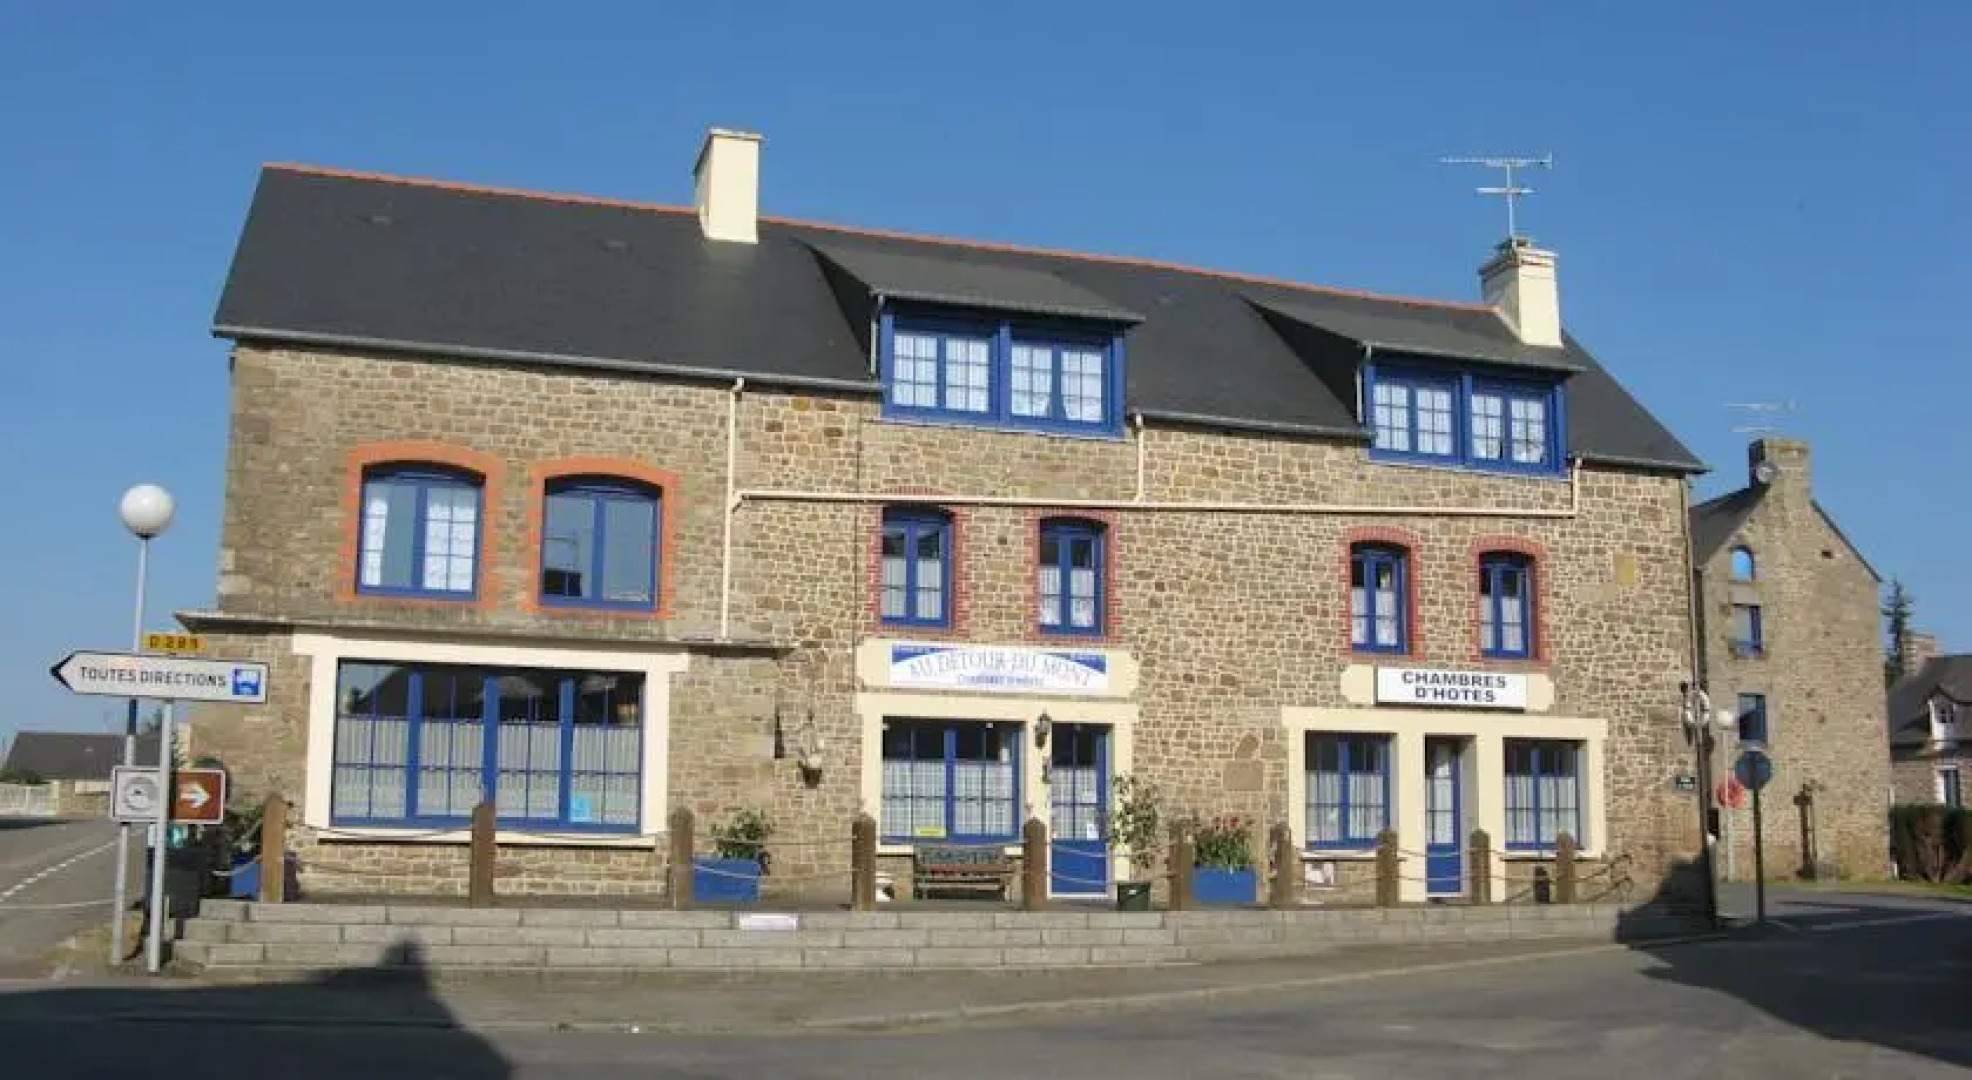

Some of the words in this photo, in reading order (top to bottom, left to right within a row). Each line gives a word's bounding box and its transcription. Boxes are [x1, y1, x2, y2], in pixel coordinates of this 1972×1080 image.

[1013, 652, 1036, 672] DU
[80, 666, 137, 682] TOUTES
[140, 671, 227, 688] DIRECTIONS
[1402, 671, 1506, 688] CHAMBRES
